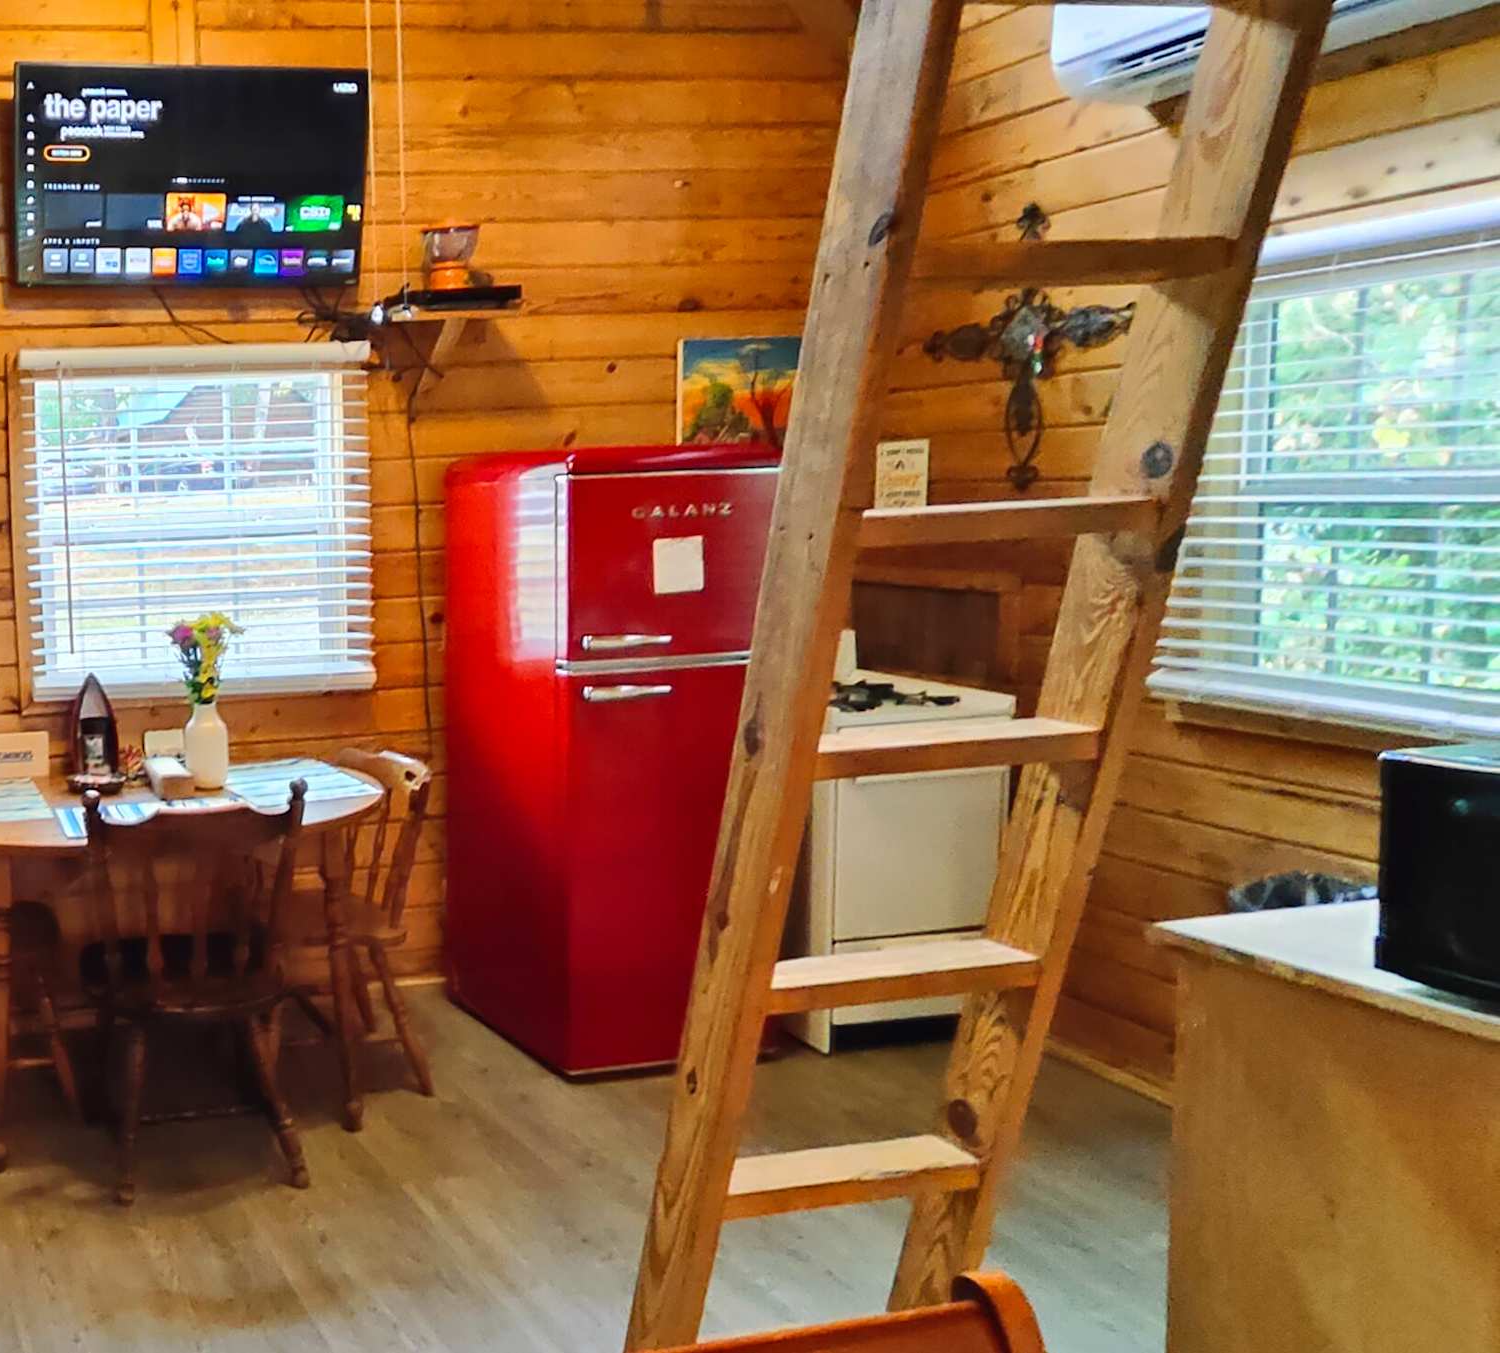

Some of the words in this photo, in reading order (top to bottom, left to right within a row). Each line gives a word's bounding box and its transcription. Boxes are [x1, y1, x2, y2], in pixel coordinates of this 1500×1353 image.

[44, 93, 86, 120] the
[90, 98, 163, 124] paper
[631, 502, 734, 519] GALANZ
